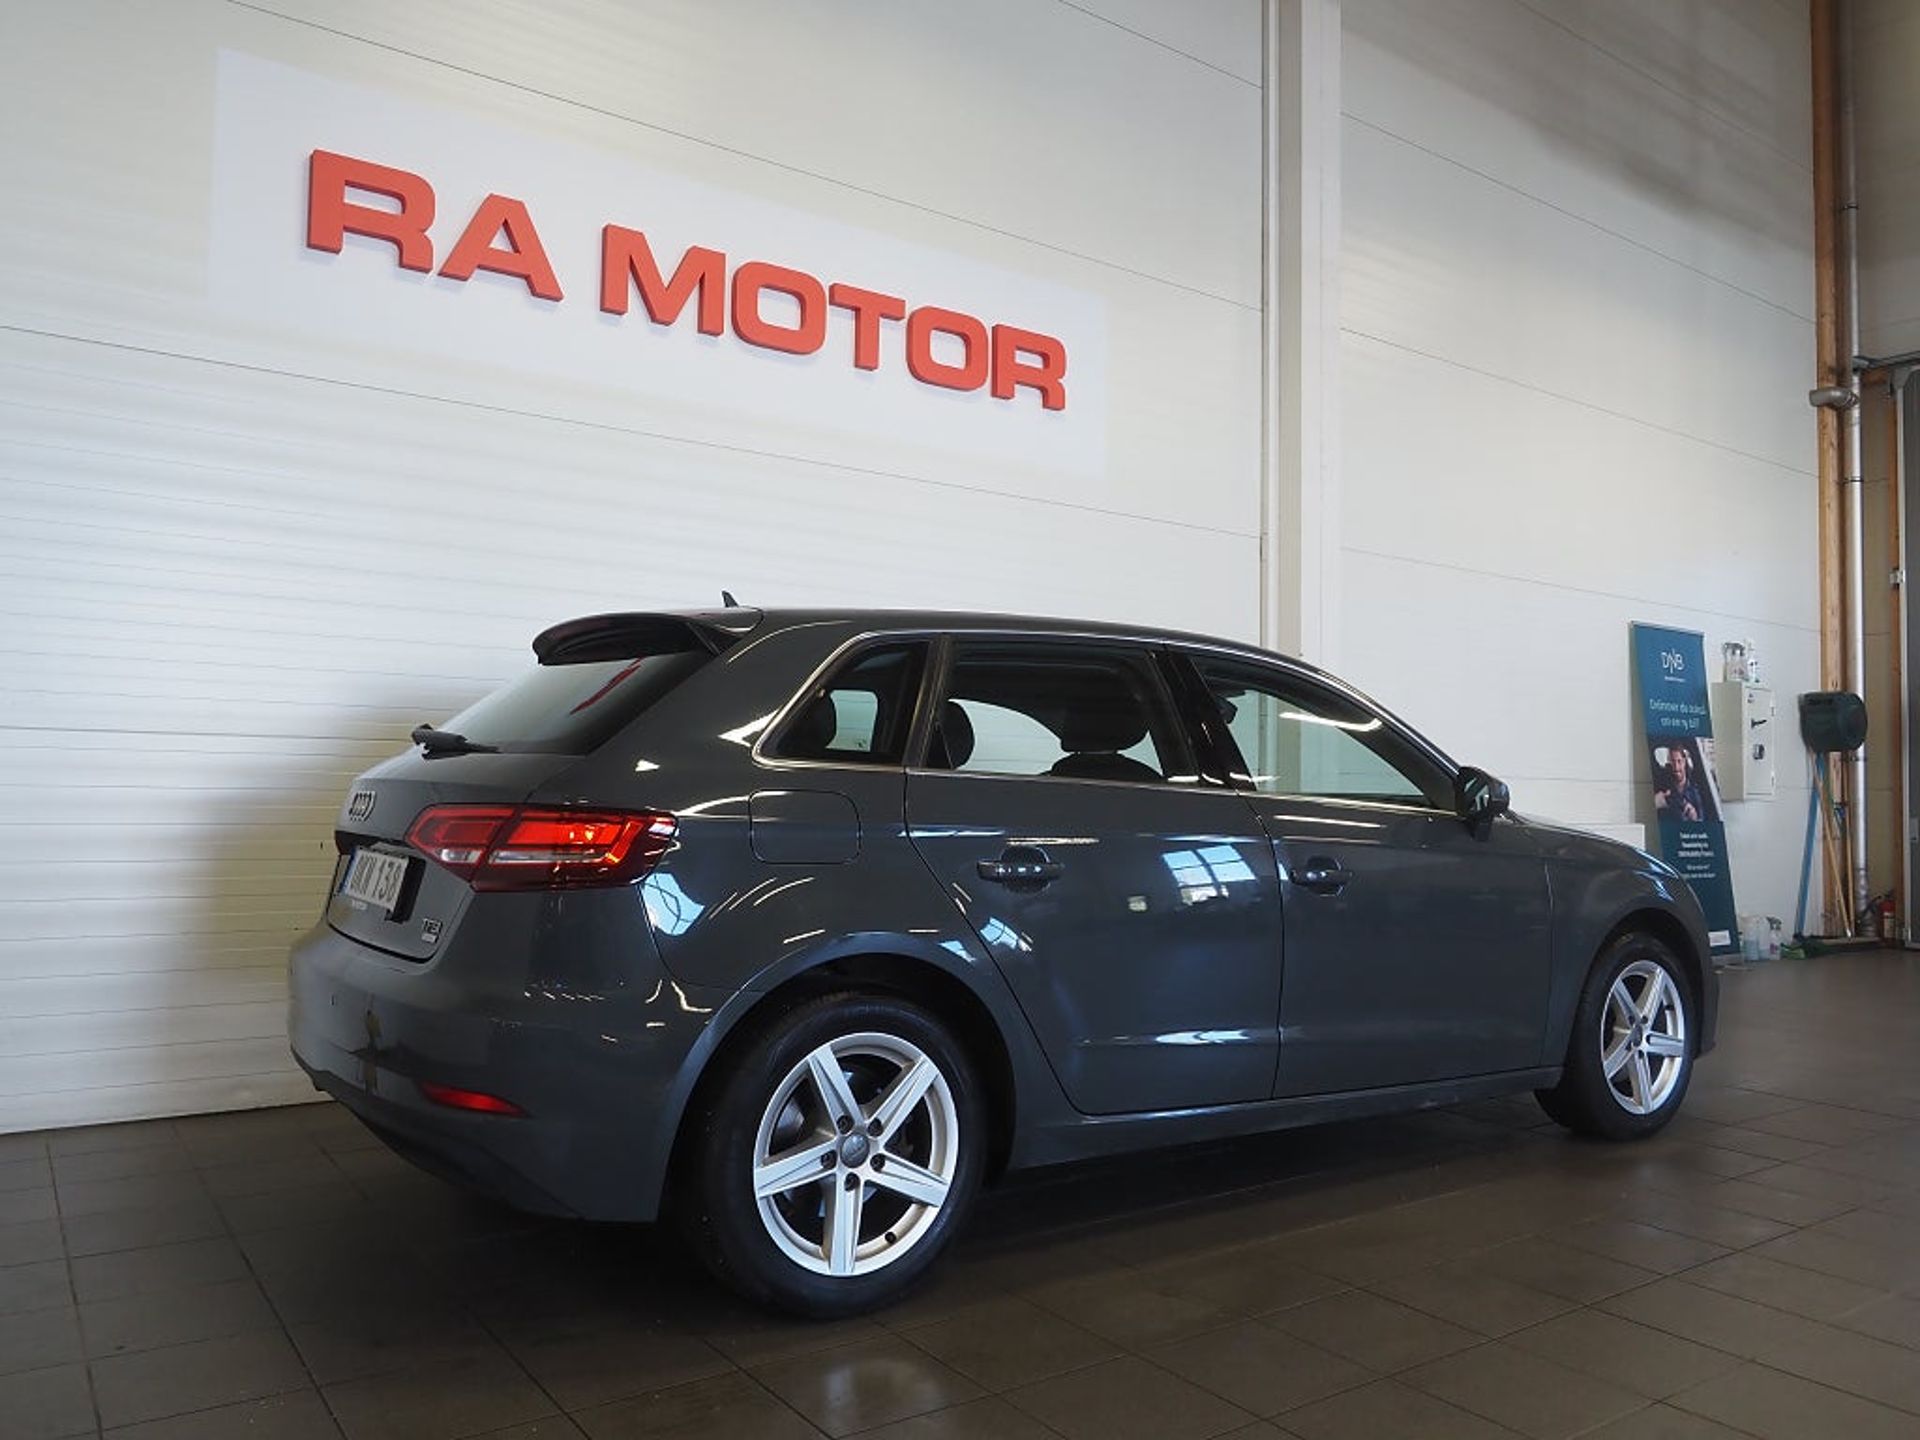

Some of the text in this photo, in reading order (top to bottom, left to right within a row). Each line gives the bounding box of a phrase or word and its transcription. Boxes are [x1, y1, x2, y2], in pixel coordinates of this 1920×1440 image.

[307, 149, 1067, 411] RA MOTOR
[1661, 648, 1685, 674] DNB
[371, 857, 402, 903] 138
